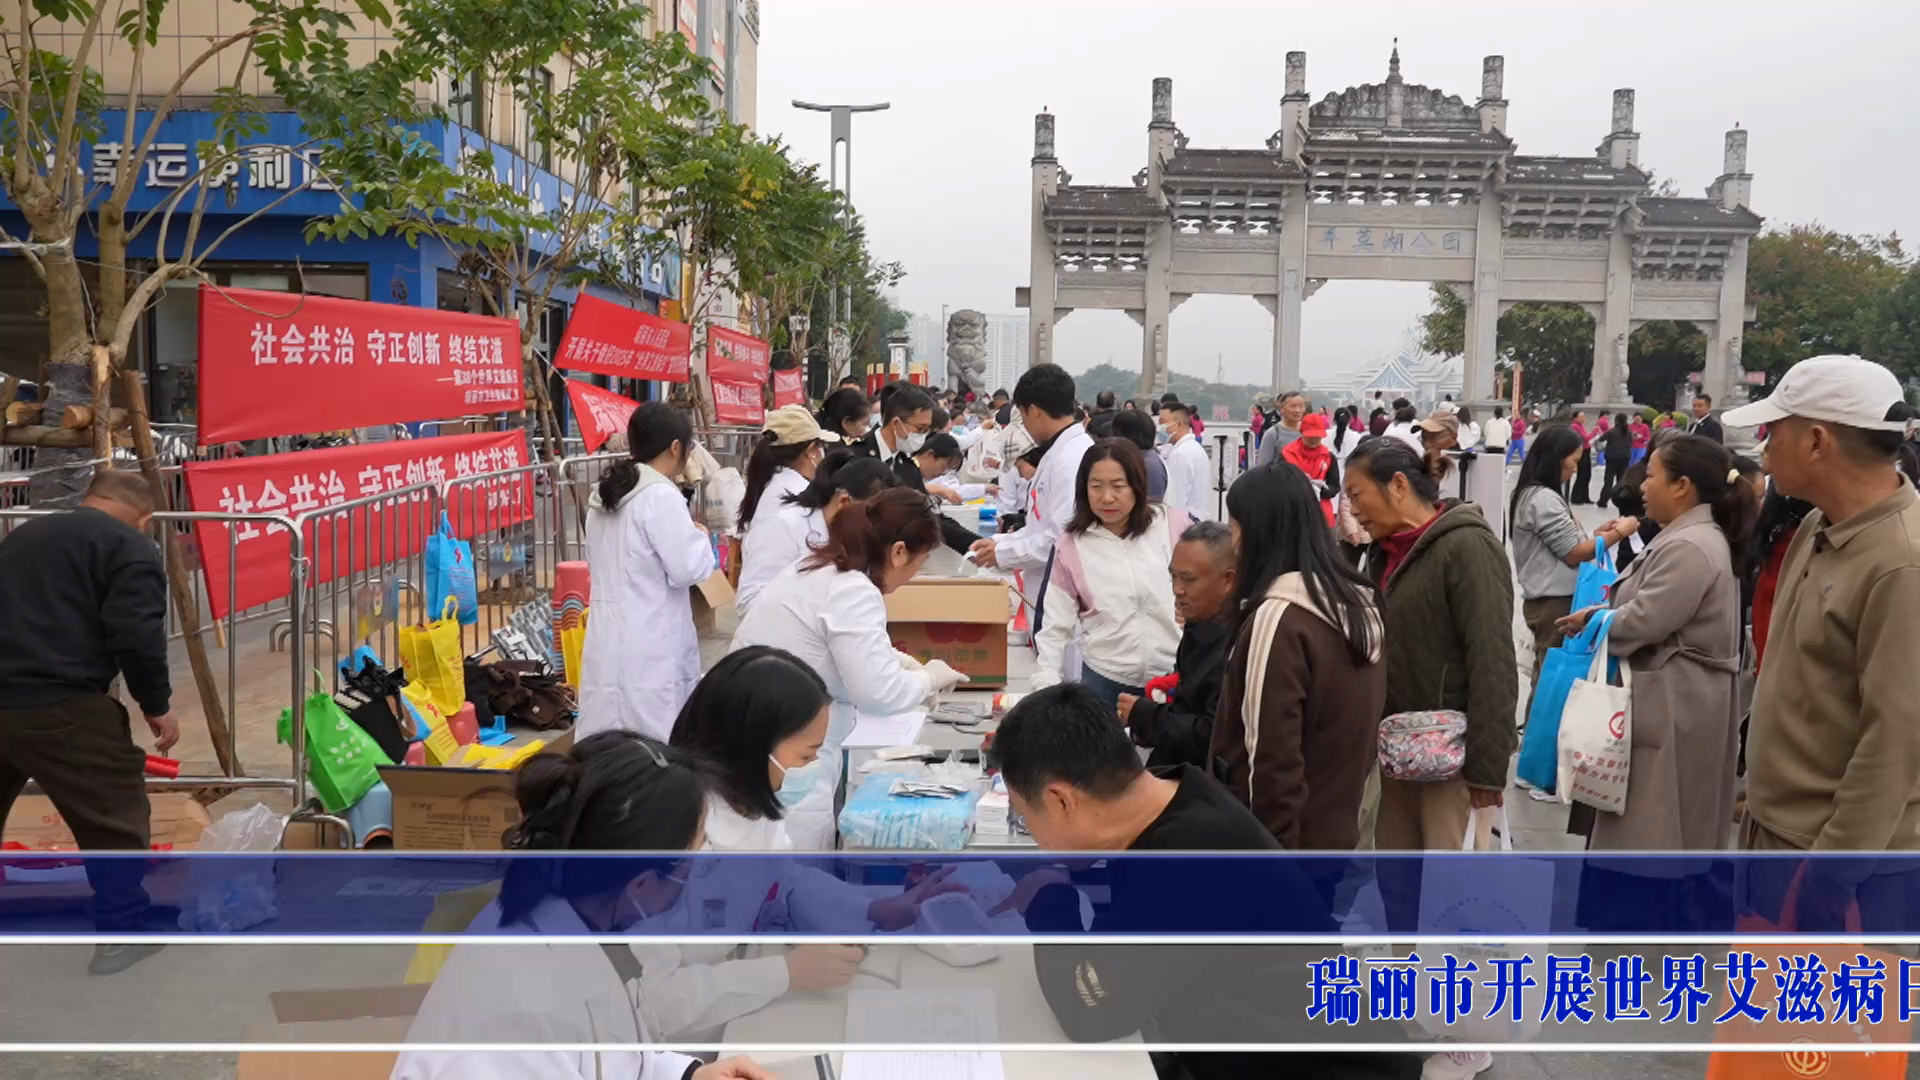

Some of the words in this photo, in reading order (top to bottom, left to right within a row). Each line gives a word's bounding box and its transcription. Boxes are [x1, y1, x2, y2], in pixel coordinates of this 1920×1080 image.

[251, 322, 355, 366] 社会共治
[367, 329, 441, 366] 守正创新
[448, 335, 504, 365] 终结艾滋
[219, 469, 347, 544] 社会共治
[358, 455, 446, 512] 守正创新
